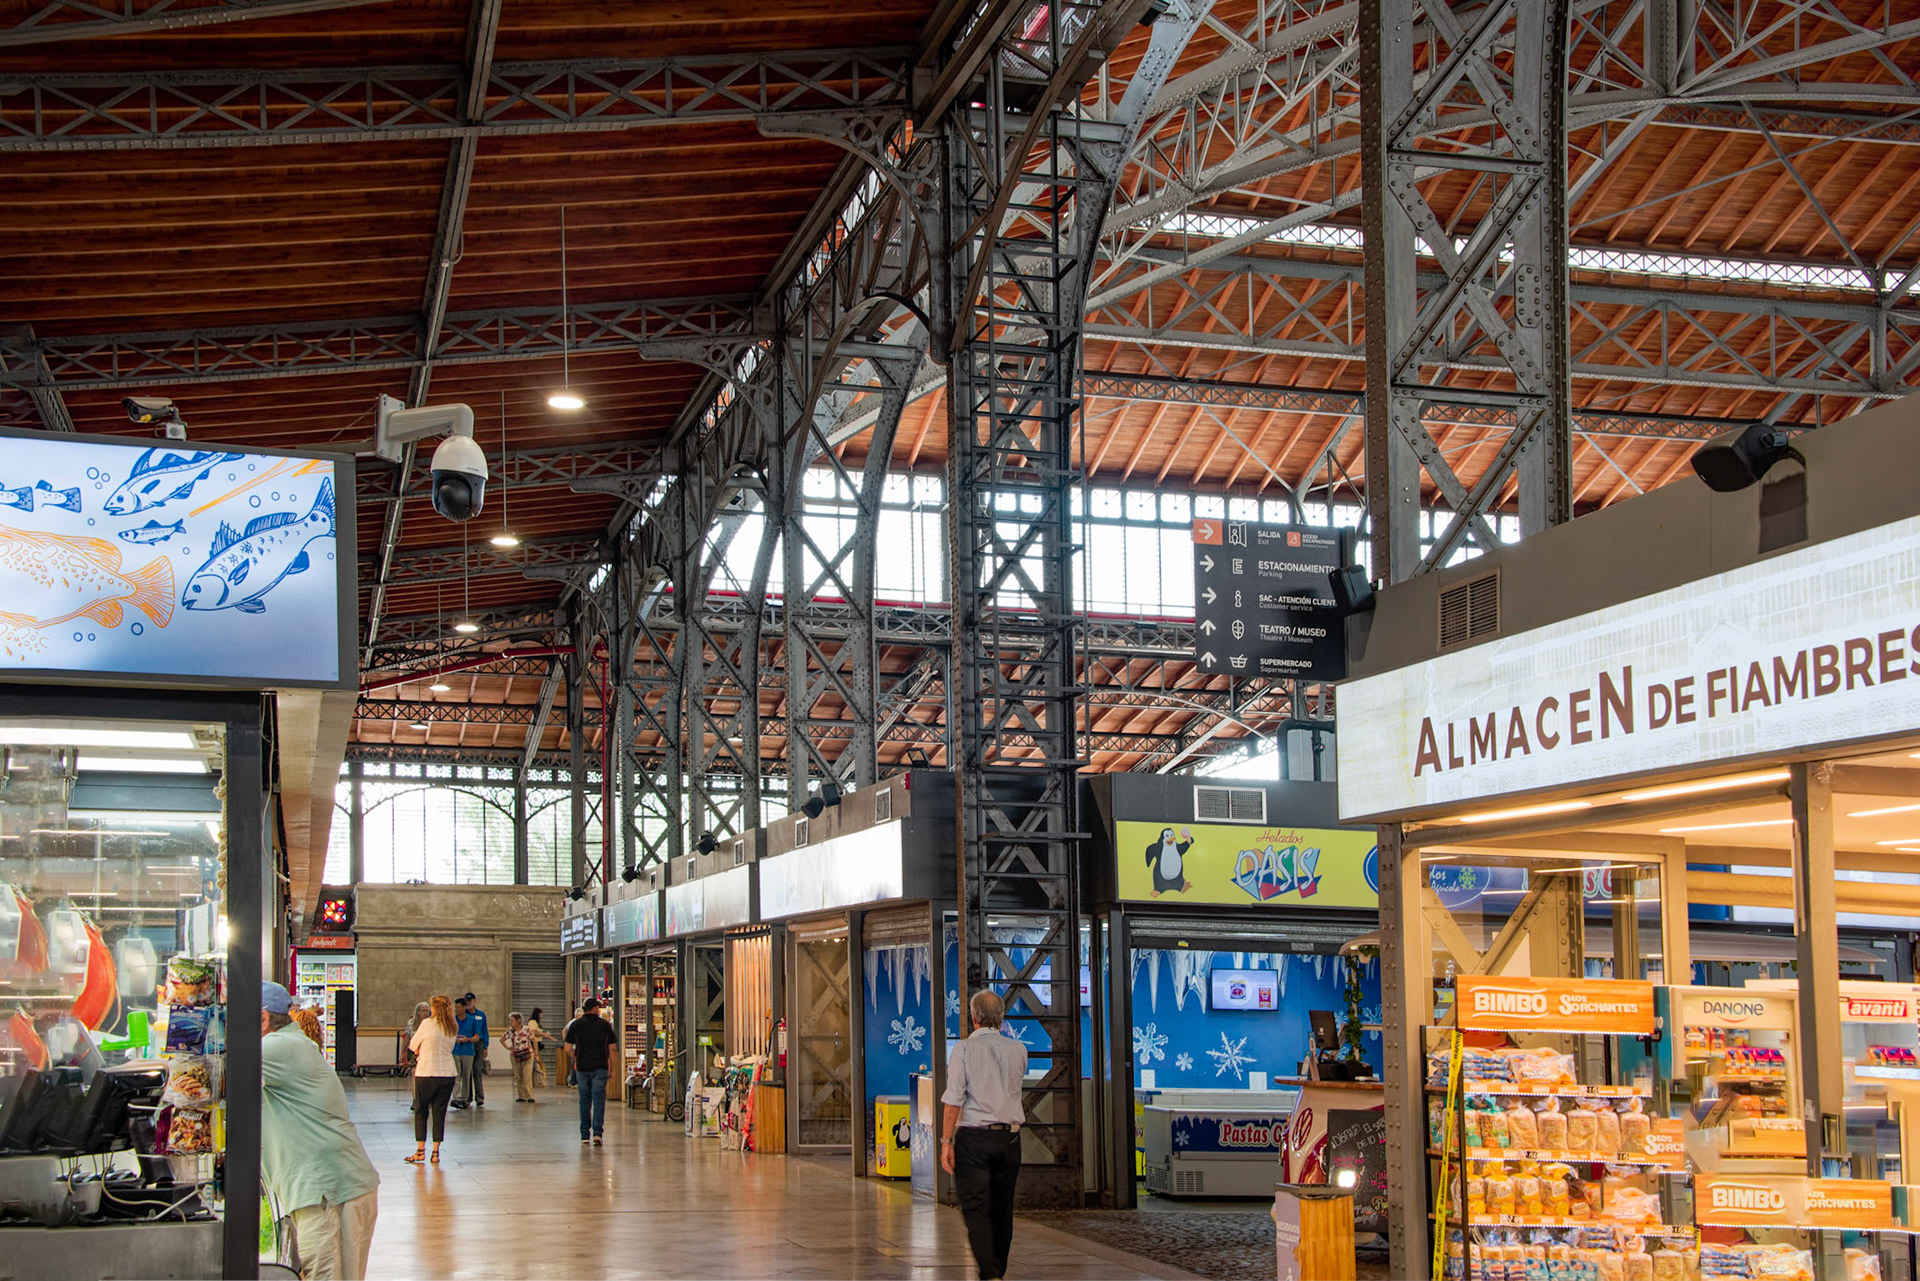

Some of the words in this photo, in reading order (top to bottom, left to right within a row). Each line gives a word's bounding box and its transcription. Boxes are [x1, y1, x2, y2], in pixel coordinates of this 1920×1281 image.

[1257, 530, 1281, 539] SALIDA
[1258, 570, 1282, 579] Parking
[1259, 594, 1273, 603] SAC
[1277, 595, 1311, 605] ATENCIÓN
[1312, 598, 1337, 607] CLIENT
[1259, 602, 1289, 611] Customer
[1290, 604, 1313, 612] service
[1259, 625, 1290, 635] TEATRO
[1297, 627, 1327, 637] MUSEO
[1259, 634, 1283, 642] Theatre
[1287, 635, 1313, 644] Museum
[1259, 658, 1312, 668] SUPERMERCADO
[1260, 665, 1299, 675] Supermarket
[1414, 665, 1634, 777] ALMACEN
[1648, 675, 1696, 729] DE
[1255, 829, 1304, 844] Helados
[1234, 844, 1314, 892] OASIS
[1474, 992, 1547, 1014] BIMBO
[1570, 995, 1587, 1003] LOS
[1850, 1000, 1906, 1017] avanti
[1221, 1123, 1269, 1145] Pastas
[1656, 1135, 1673, 1143] LOS
[1712, 1188, 1785, 1209] BIMBO
